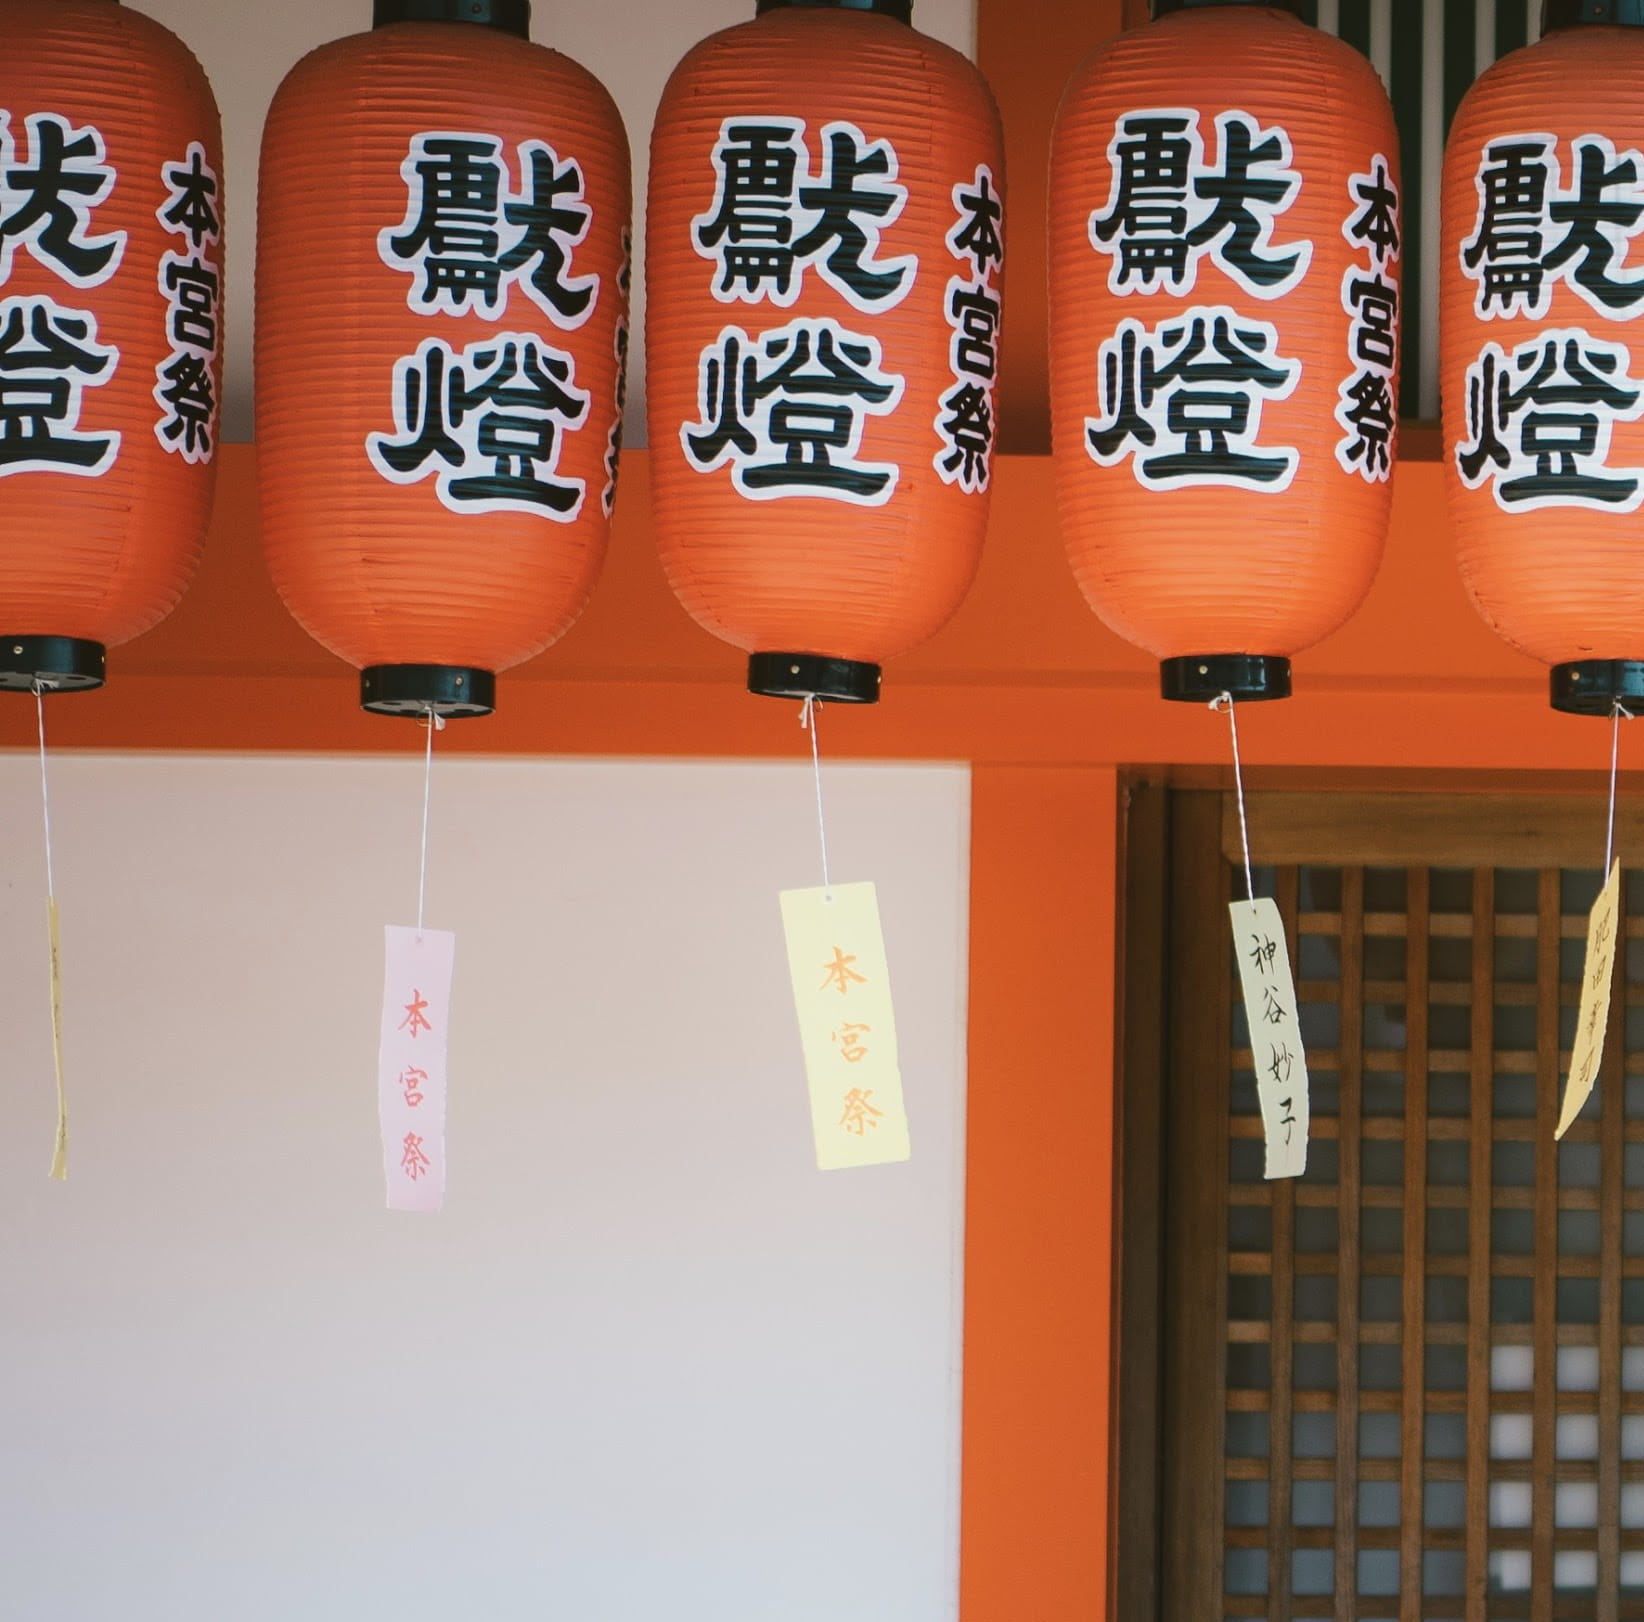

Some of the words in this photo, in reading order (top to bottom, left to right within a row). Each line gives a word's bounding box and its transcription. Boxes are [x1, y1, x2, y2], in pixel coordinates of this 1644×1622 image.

[157, 144, 220, 461] 本宮祭
[937, 168, 1003, 491] 本宮祭
[1338, 157, 1398, 480] 本宮祭
[397, 988, 432, 1182] 本宮祭
[819, 945, 886, 1137] 本宮祭
[1248, 933, 1297, 1146] 神谷妙子
